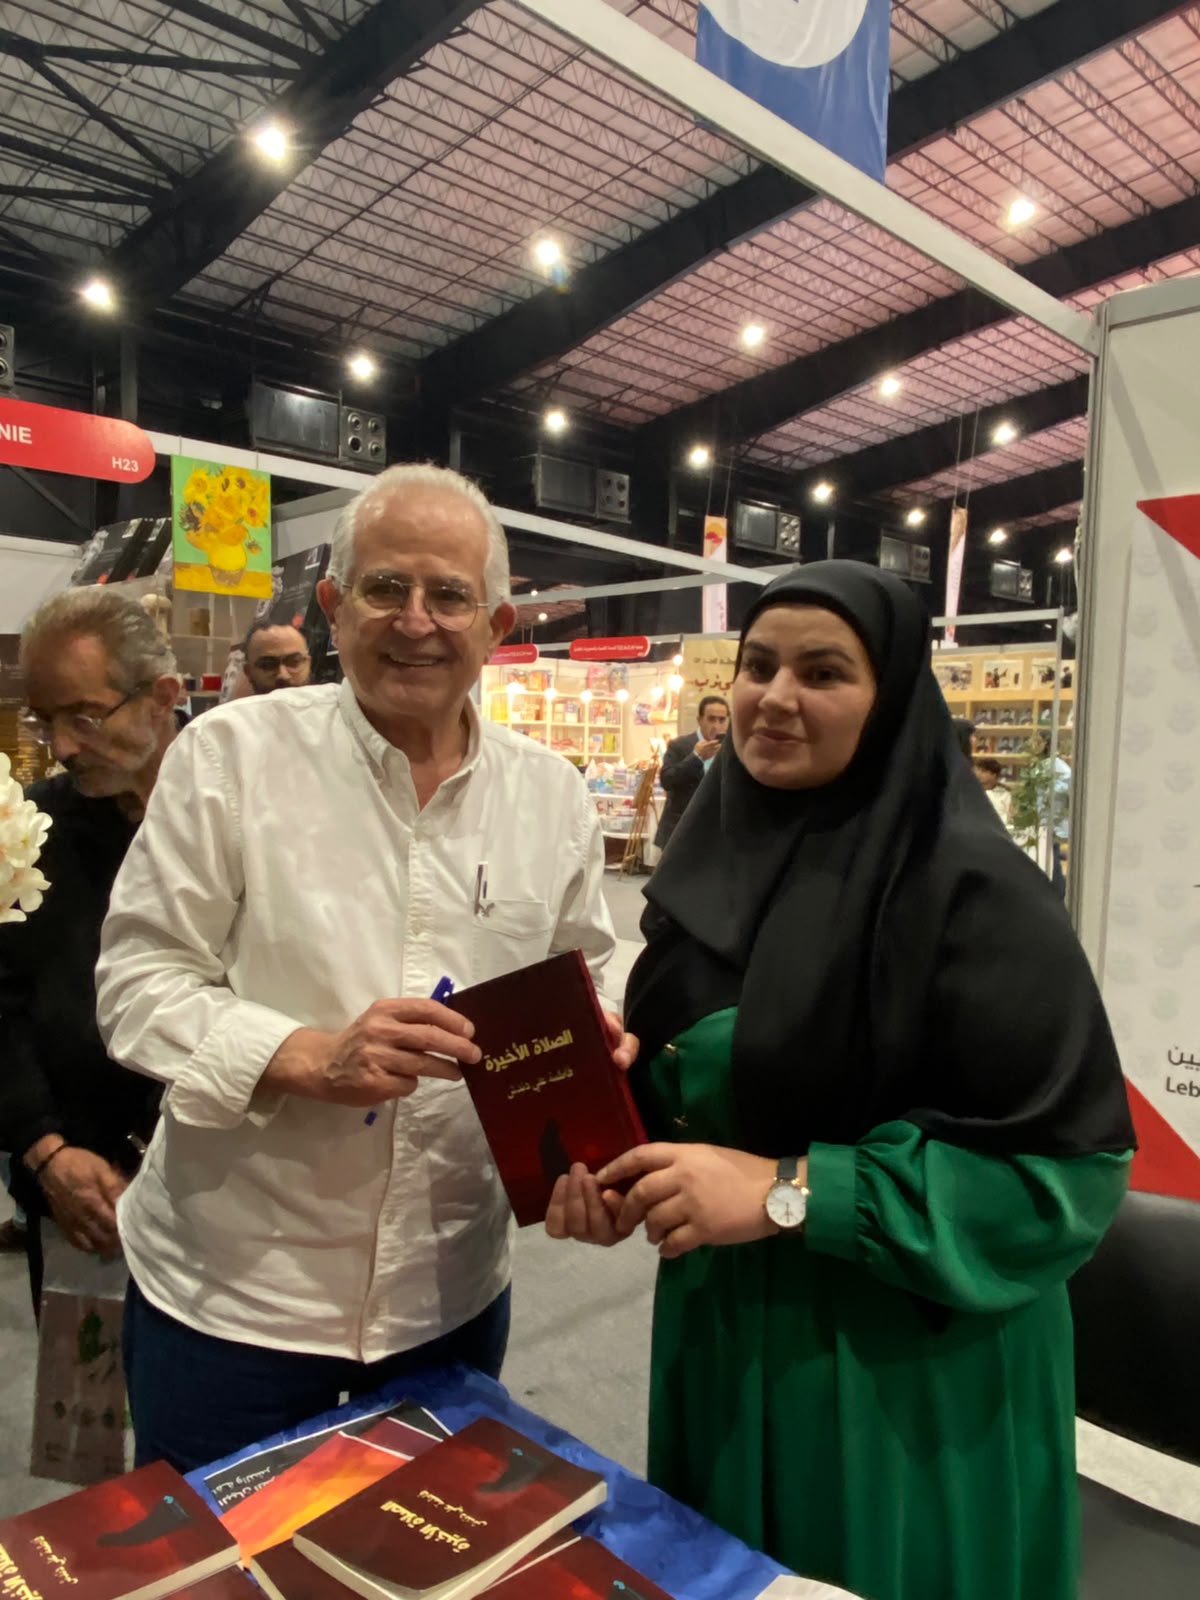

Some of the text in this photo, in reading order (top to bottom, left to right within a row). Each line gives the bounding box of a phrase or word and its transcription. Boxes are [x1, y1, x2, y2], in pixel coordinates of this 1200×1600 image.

[111, 456, 139, 473] H23
[483, 1028, 574, 1073] الصلاة الأخيرة
[1166, 1076, 1200, 1098] Leb
[380, 1500, 471, 1553] الصلاة الأخيرة
